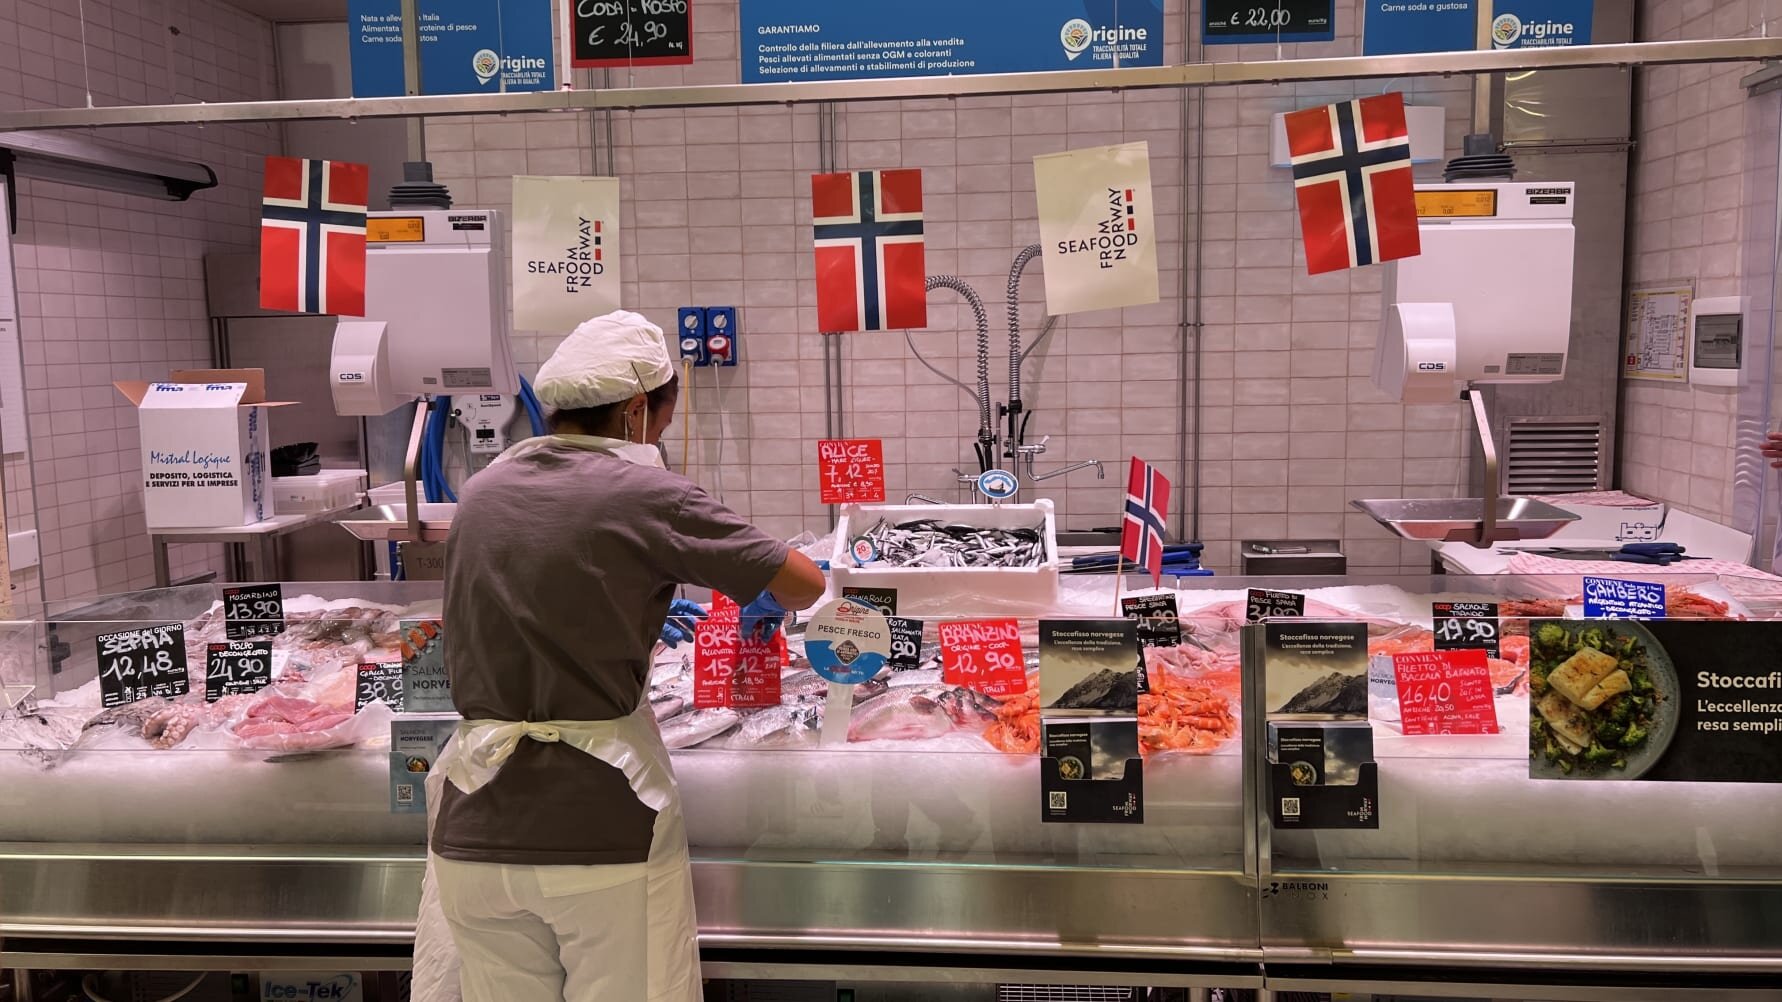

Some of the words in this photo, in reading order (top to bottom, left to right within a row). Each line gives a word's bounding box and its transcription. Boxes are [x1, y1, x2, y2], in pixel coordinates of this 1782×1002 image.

[1381, 3, 1406, 12] Carne
[1408, 3, 1427, 11] soda
[1436, 2, 1468, 12] gustosa
[1230, 11, 1240, 25] €
[1245, 7, 1291, 31] 22,00
[455, 25, 477, 33] pesce
[588, 25, 605, 45] €
[614, 20, 667, 47] 24,90
[758, 24, 820, 34] GARANTIAMO
[361, 35, 384, 43] Carne
[758, 44, 797, 53] Controllo
[798, 43, 819, 51] della
[821, 41, 845, 50] filiera
[846, 40, 913, 49] dall'allevamento
[915, 38, 931, 47] alla
[932, 37, 964, 46] vendita
[758, 55, 780, 63] Pesci
[782, 54, 812, 63] allevati
[813, 52, 855, 62] alimentati
[882, 51, 905, 59] OGM
[914, 49, 952, 58] coloranti
[1093, 52, 1112, 60] FILIERA
[759, 66, 798, 74] Selezione
[800, 64, 808, 73] di
[809, 63, 858, 72] allevamenti
[866, 61, 916, 70] stabilimenti
[917, 61, 926, 69] di
[927, 59, 975, 70] produzione
[1108, 188, 1126, 260] NORWAY
[1058, 233, 1138, 254] SEAFOOD
[1098, 220, 1113, 269] FROM
[579, 217, 592, 287] NORWAY
[528, 261, 604, 275] SEAFOOD
[566, 247, 578, 293] FROM
[150, 451, 190, 465] Mistral
[193, 450, 231, 469] Logique
[821, 444, 868, 459] ALICE
[150, 472, 191, 480] DEPOSITO,
[1586, 583, 1660, 603] GAMBERO
[697, 624, 741, 632] CONVIEN
[887, 619, 908, 628] ROTA
[1437, 618, 1495, 641] 19,90
[98, 630, 140, 642] OCCASIONE
[154, 624, 182, 634] GIORNO
[818, 624, 845, 635] PESCE
[847, 628, 881, 640] FRESCO
[942, 623, 1020, 646] BRANZINO
[102, 651, 172, 681] 12,48
[704, 656, 763, 677] 15,12
[948, 651, 1015, 676] 12,90
[1397, 664, 1437, 673] FILETTO
[1442, 662, 1451, 670] DI
[1401, 670, 1442, 681] BACCALÀ
[412, 680, 451, 689] NORVE
[1402, 682, 1451, 706] 16,40
[1697, 721, 1729, 731] resa
[1733, 718, 1782, 734] sempli
[264, 981, 344, 999] Ice-Tek
